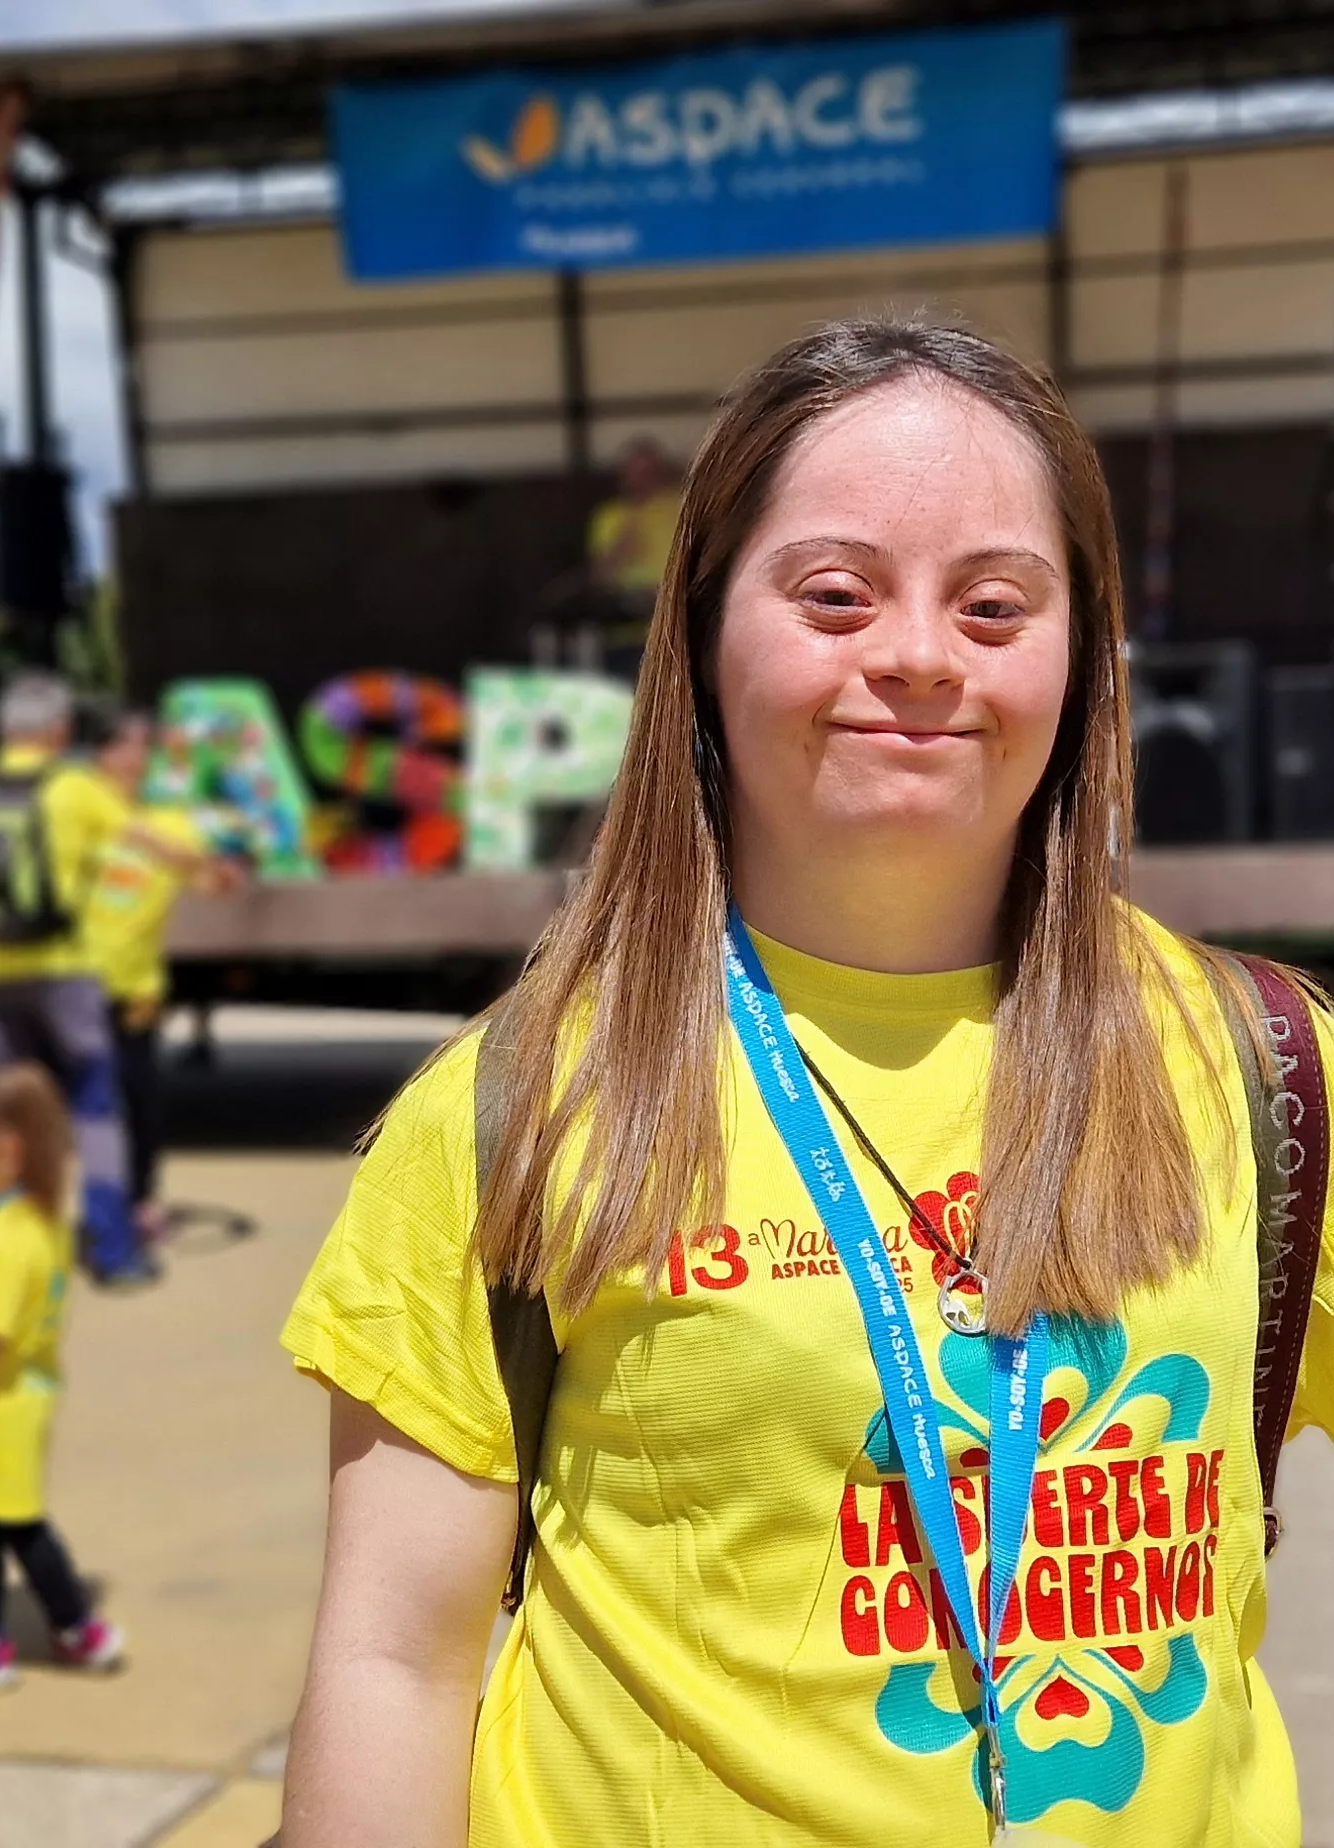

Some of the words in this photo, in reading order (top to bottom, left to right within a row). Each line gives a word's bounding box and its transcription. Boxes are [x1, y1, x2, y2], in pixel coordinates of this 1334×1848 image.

[565, 66, 920, 168] ASPACE
[771, 1259, 841, 1280] ASPACE
[840, 1481, 923, 1569] LA
[950, 1455, 1171, 1558] SERTE
[1185, 1449, 1225, 1530] DE
